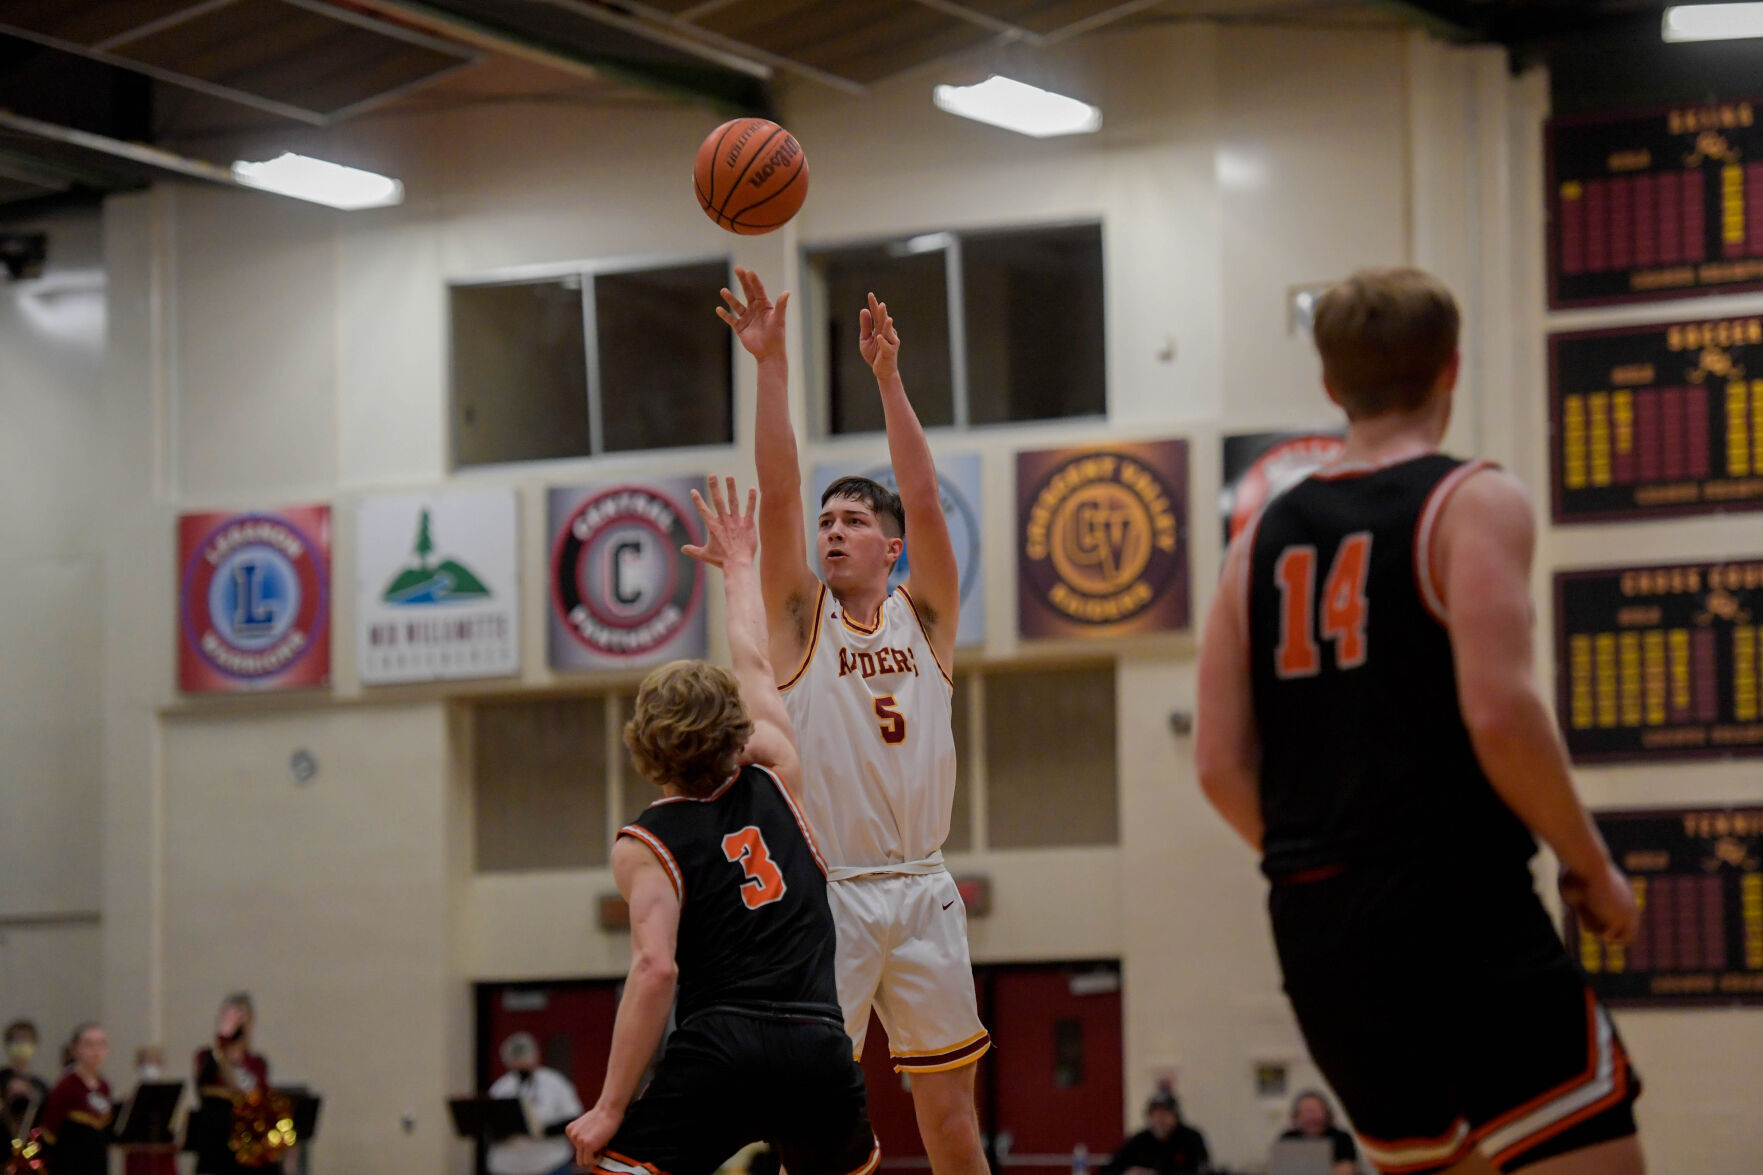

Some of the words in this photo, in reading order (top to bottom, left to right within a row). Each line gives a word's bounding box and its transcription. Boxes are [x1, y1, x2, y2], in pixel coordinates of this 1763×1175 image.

[748, 134, 801, 188] Wilson
[231, 557, 277, 633] L
[607, 535, 648, 611] C
[1706, 563, 1763, 591] COU
[1274, 531, 1374, 680] 14
[838, 645, 919, 680] RDER
[873, 693, 907, 746] 5
[1683, 811, 1763, 840] TENNI
[721, 825, 787, 911] 3
